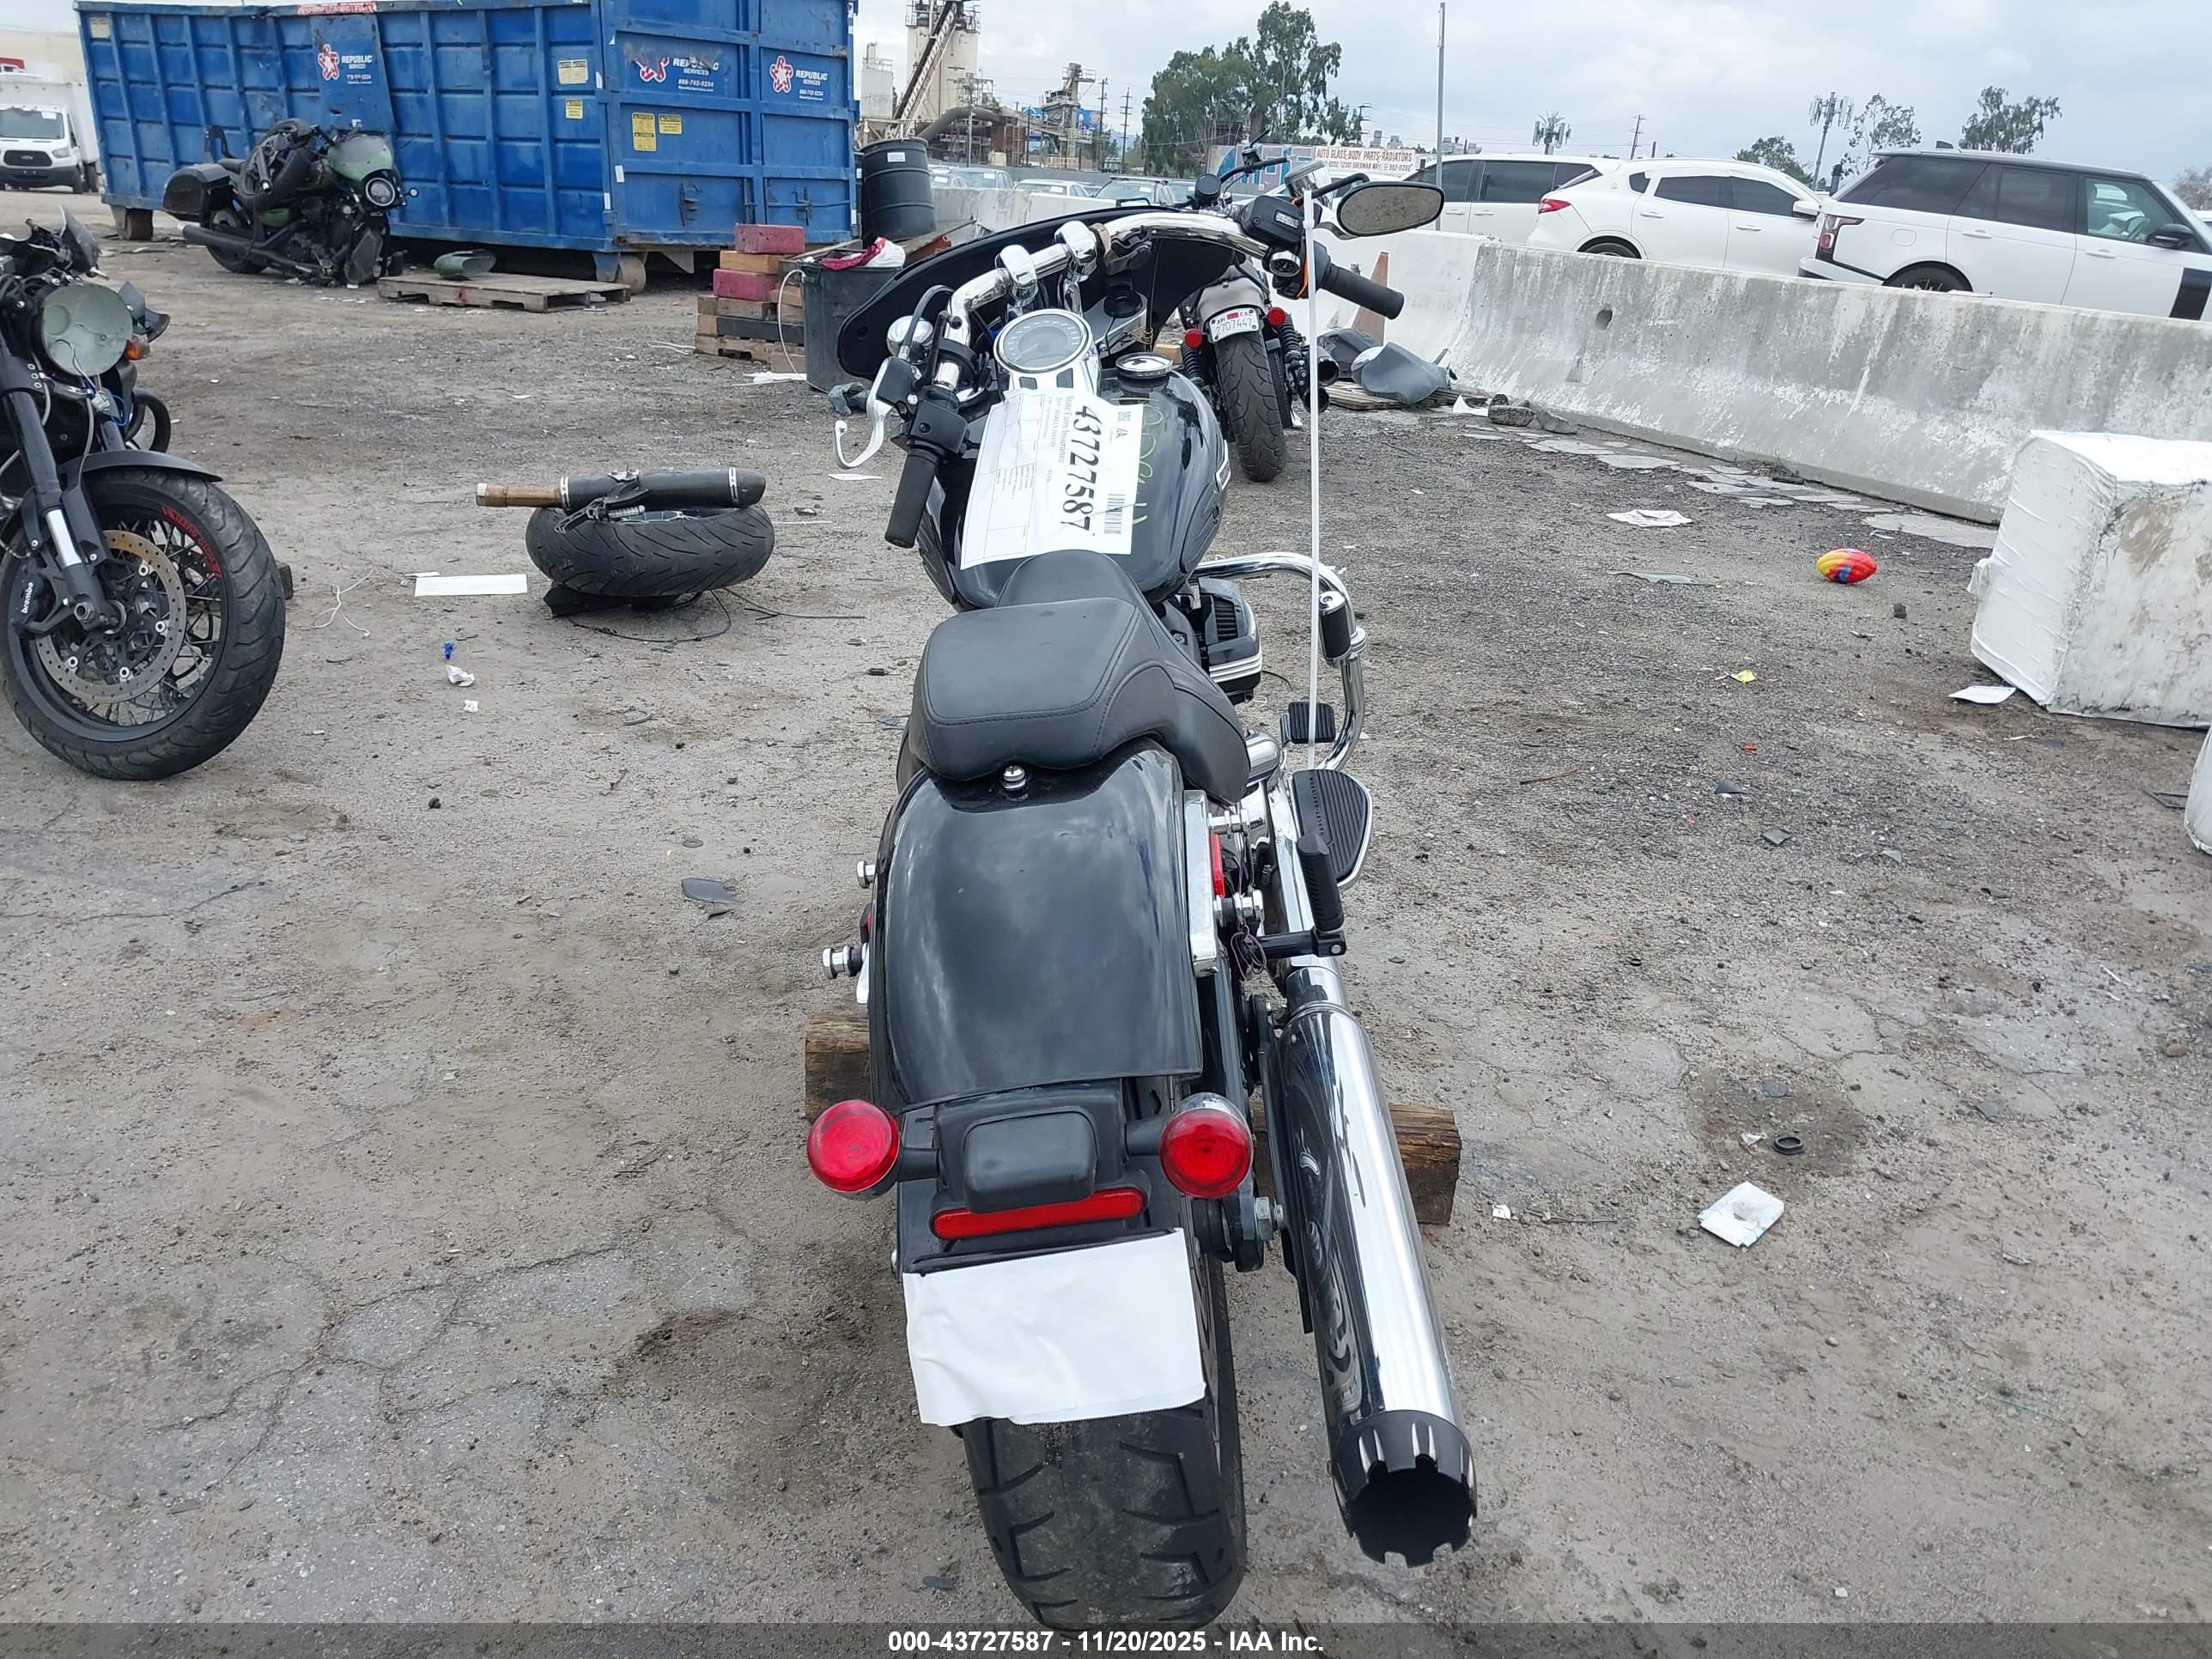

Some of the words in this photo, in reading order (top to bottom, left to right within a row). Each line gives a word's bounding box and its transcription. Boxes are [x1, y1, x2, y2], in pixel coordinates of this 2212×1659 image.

[341, 55, 373, 64] REPUBLIC
[795, 70, 829, 81] REPUBLIC
[1316, 148, 1329, 159] AUTO
[1064, 395, 1074, 411] State
[1061, 412, 1072, 428] Farm
[1058, 429, 1070, 464] Insurance
[1060, 404, 1103, 532] 43727587
[21, 582, 33, 614] brembo
